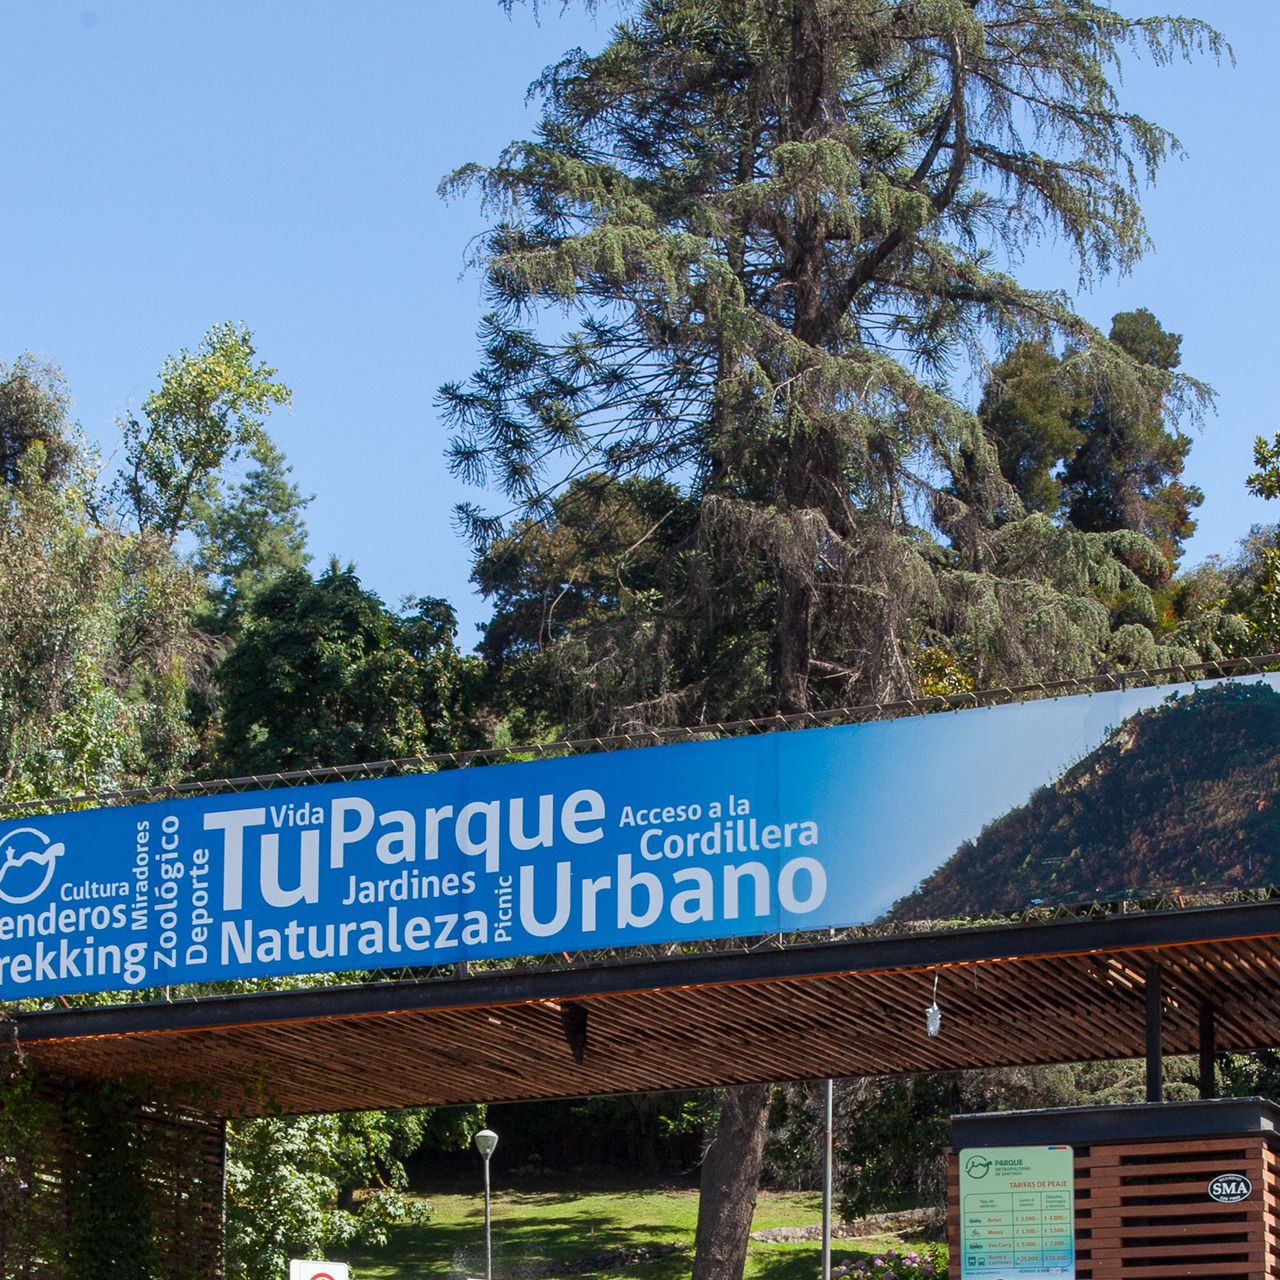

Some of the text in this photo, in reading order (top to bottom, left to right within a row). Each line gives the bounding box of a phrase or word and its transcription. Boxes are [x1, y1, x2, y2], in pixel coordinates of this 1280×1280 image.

[270, 803, 325, 829] Vida
[330, 789, 606, 873] Parque
[619, 795, 750, 828] Acceso a la
[640, 818, 818, 861] Cordillera
[60, 879, 130, 902] Cultura
[131, 820, 150, 931] Miradores
[203, 807, 320, 912] Tu
[342, 868, 476, 906] Jardines
[154, 815, 184, 970] Zoológico
[186, 848, 214, 965] Deporte
[494, 875, 512, 943] Picnic
[520, 854, 827, 938] Urbano
[221, 907, 488, 966] Naturaleza
[1212, 1182, 1248, 1195] SMA
